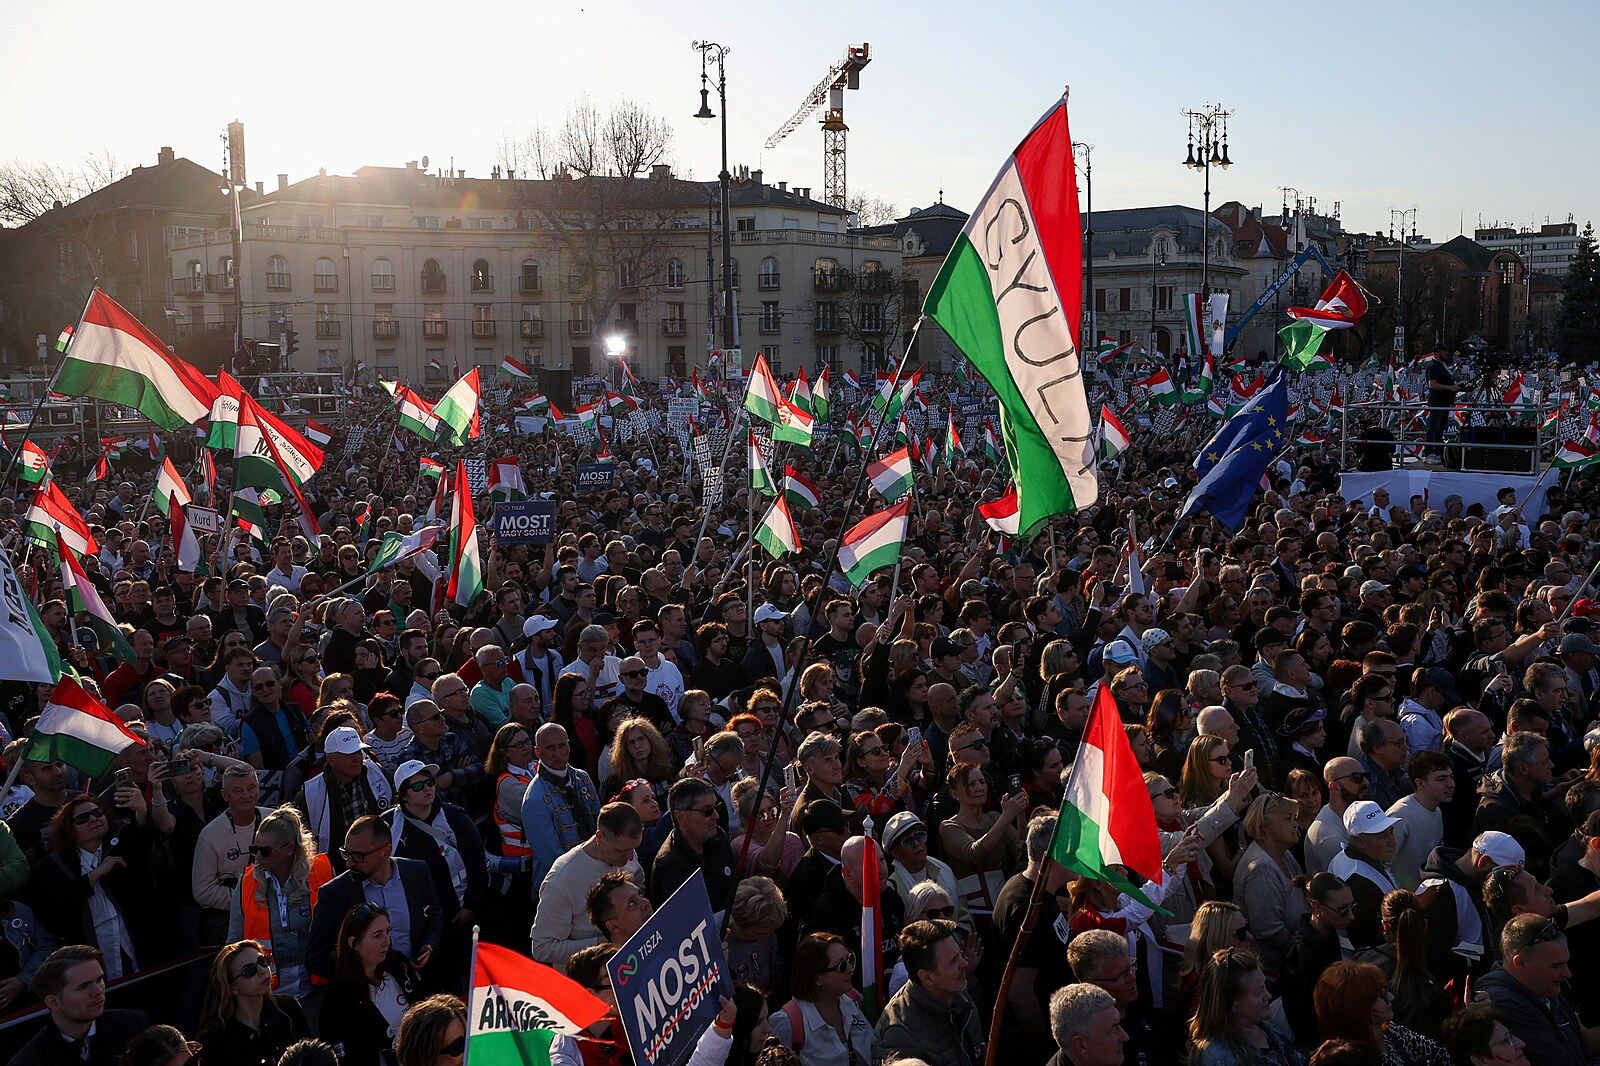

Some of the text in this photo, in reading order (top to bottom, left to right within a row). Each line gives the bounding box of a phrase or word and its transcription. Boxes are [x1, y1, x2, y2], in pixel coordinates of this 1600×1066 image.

[962, 403, 979, 412] MOST
[579, 471, 611, 481] MOST
[193, 512, 211, 527] Kurd
[499, 514, 551, 530] MOST
[499, 528, 550, 538] VAGY SOHA!
[637, 930, 663, 960] TISZA
[633, 918, 711, 1044] MOST
[643, 1008, 681, 1065] VAGY
[680, 961, 721, 1021] SOHA!
